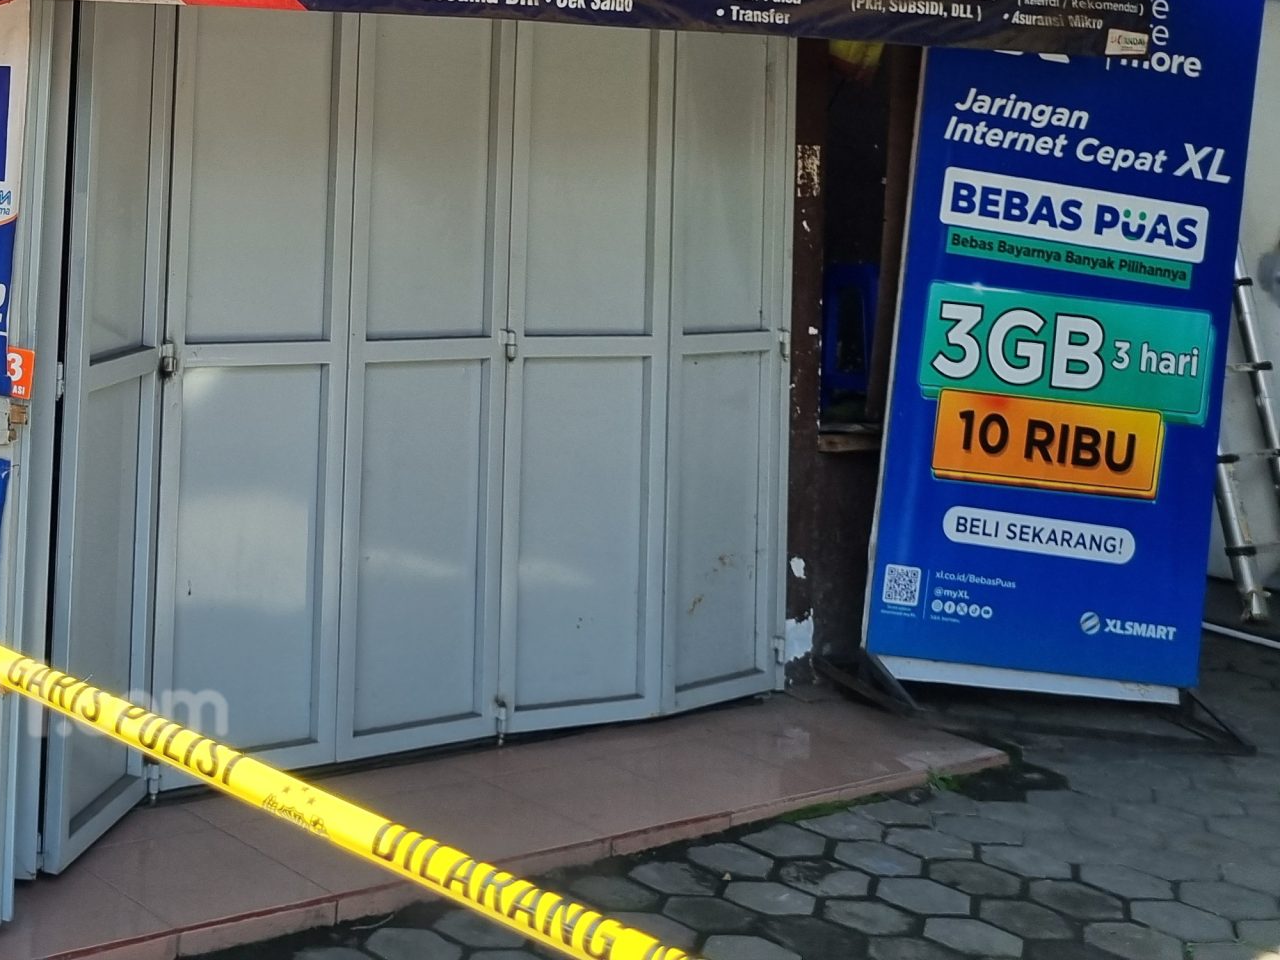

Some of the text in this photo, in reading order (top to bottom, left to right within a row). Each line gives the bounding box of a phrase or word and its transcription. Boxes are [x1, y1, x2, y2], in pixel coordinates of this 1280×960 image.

[730, 6, 791, 24] Transfer
[951, 4, 974, 19] DLL
[1011, 10, 1103, 30] Asuransi Mikro
[955, 88, 1089, 130] Jaringan
[944, 116, 1233, 184] Internet Cepat XL
[950, 180, 1083, 232] BEBAS
[951, 233, 1188, 283] Bebas Bayarnya Banyak Pilihannya
[931, 300, 1200, 391] 3GB 3 hari
[958, 410, 1137, 473] 10 RIBU
[955, 516, 1124, 555] BELI SEKARANG!
[934, 586, 970, 600] @myXL
[935, 570, 1016, 589] xl.co.id/BebasPuas
[1104, 617, 1177, 640] XLSMART
[8, 657, 625, 960] GARIS POLISI DILARANG
